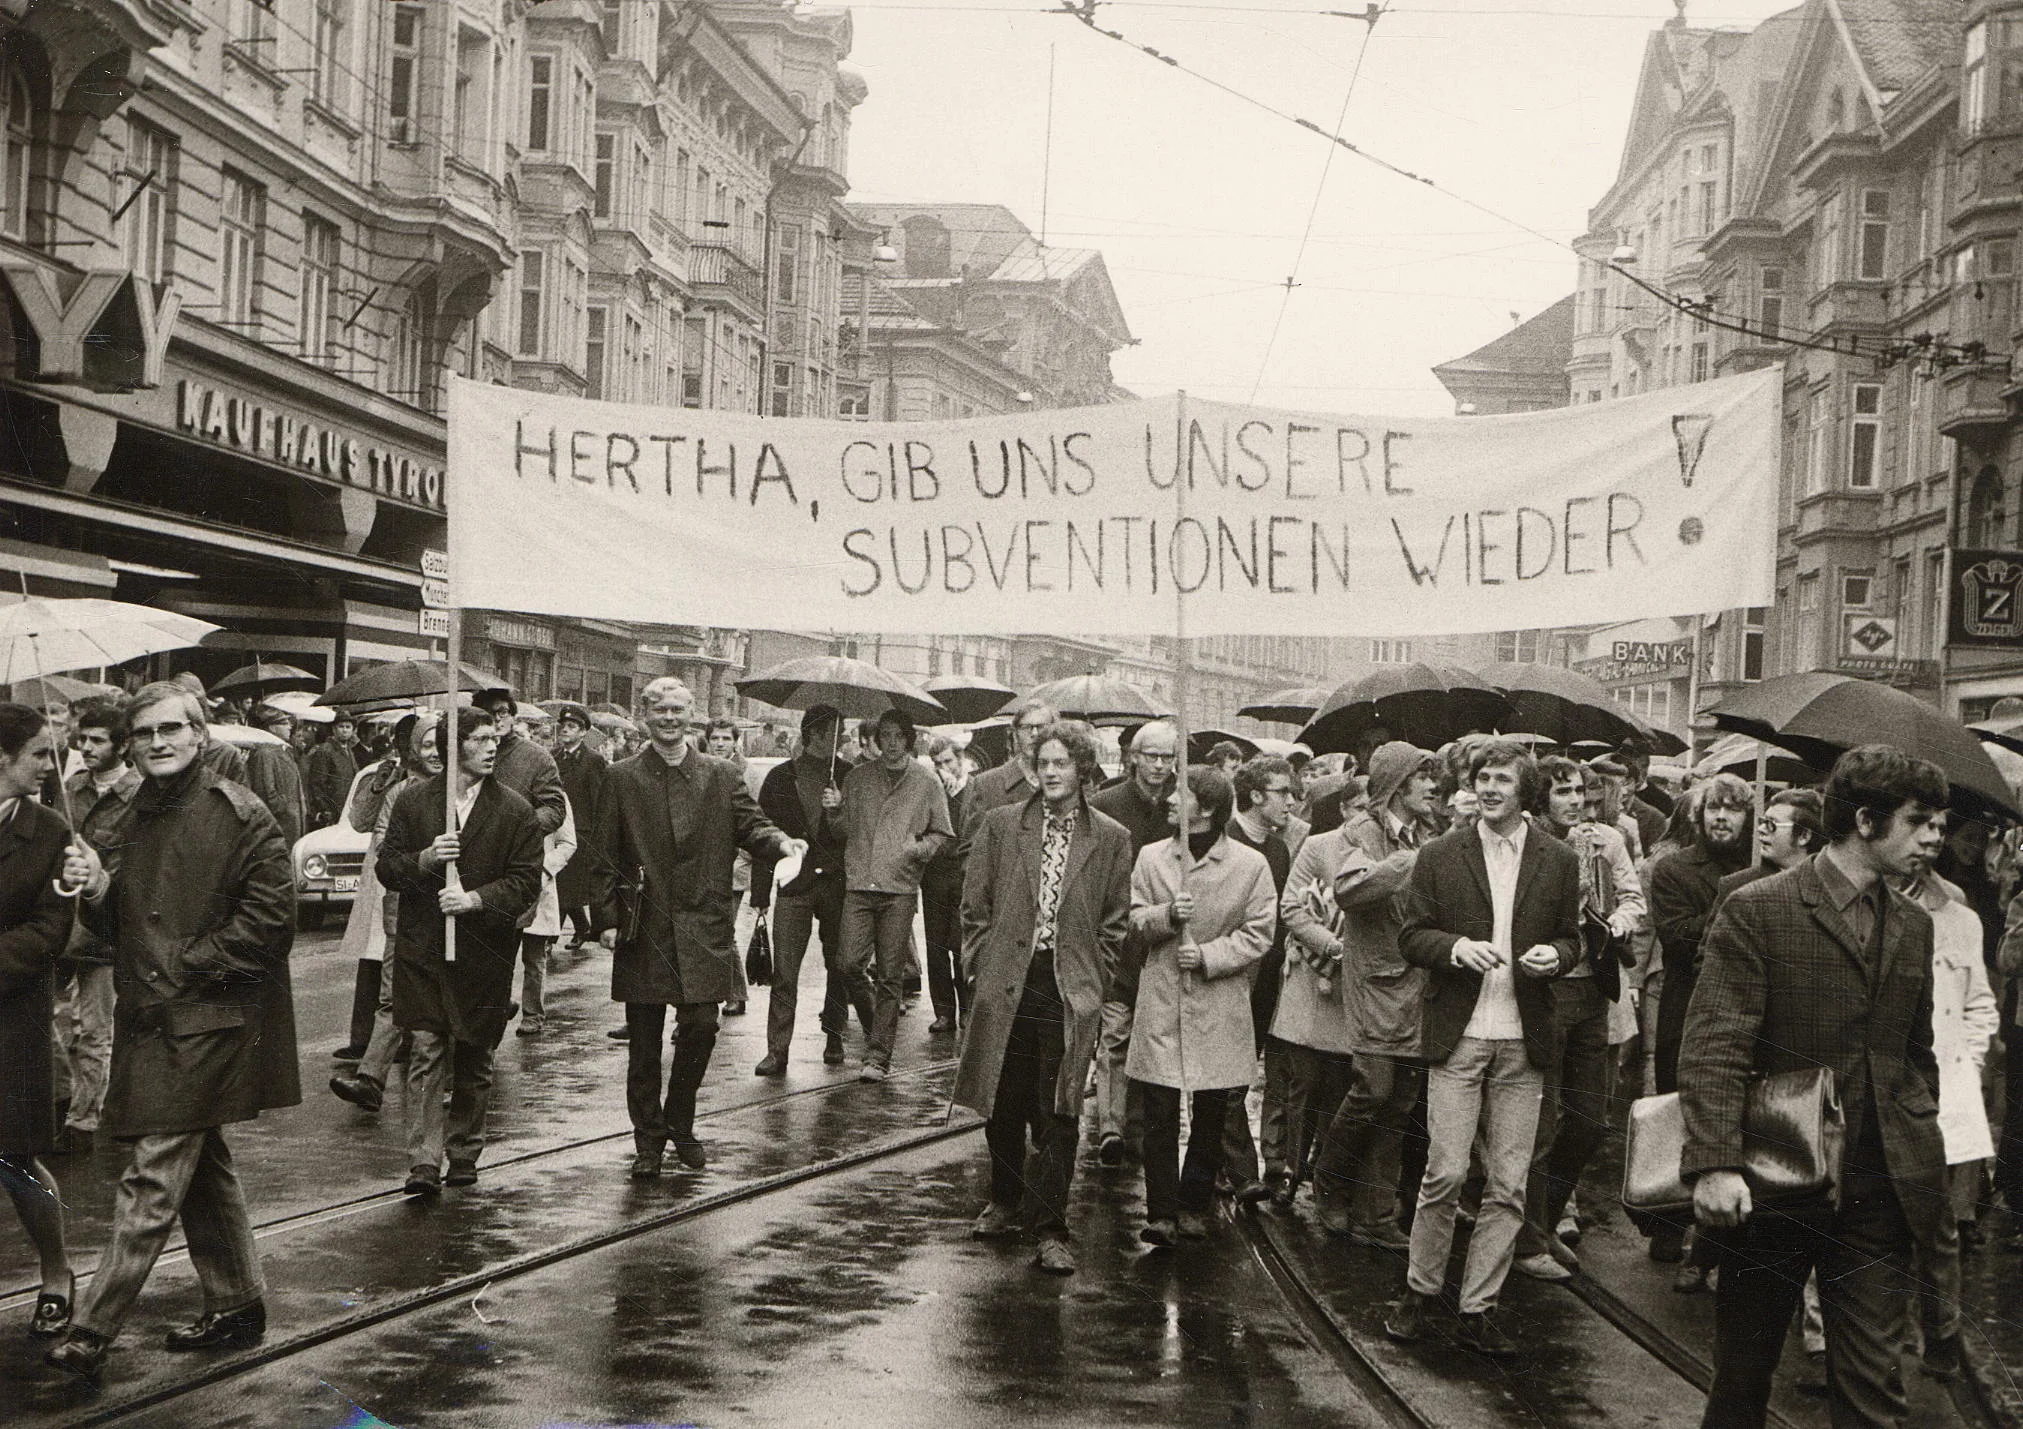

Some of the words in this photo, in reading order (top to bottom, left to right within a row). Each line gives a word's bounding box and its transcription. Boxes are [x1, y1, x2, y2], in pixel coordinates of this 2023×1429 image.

[179, 380, 360, 480] KAUFHAUS
[512, 418, 820, 523] HERTHA,
[839, 438, 941, 502] GIB
[969, 432, 1096, 499] UNS
[1144, 418, 1414, 499] UNSERE
[840, 515, 1351, 599] SUBVENTIONEN
[1613, 642, 1688, 664] BANK
